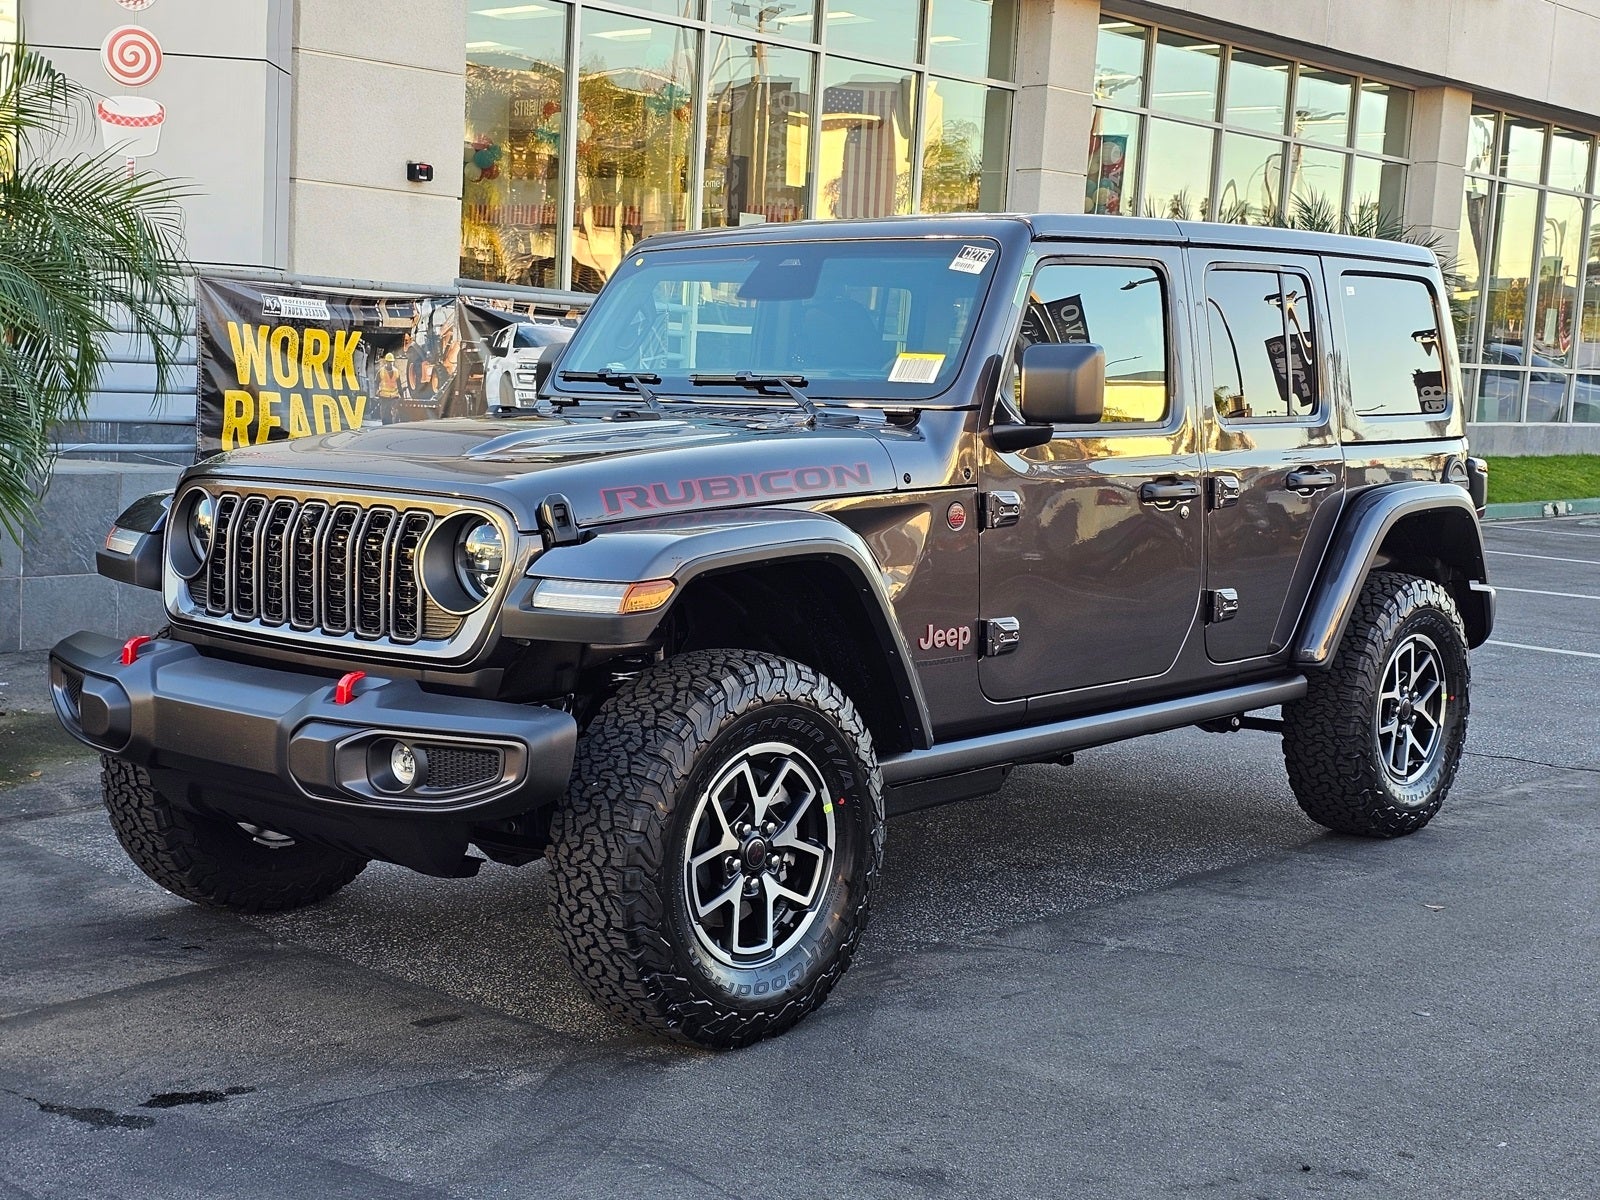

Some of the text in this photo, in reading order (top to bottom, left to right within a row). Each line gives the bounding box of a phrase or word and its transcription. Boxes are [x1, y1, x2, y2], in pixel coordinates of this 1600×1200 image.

[281, 298, 323, 307] PROFESSIONAL
[284, 305, 328, 319] TRUCK SEASON
[227, 321, 362, 391] WORK
[221, 389, 367, 451] READY
[601, 463, 873, 515] RUBICON
[918, 624, 971, 651] Jeep
